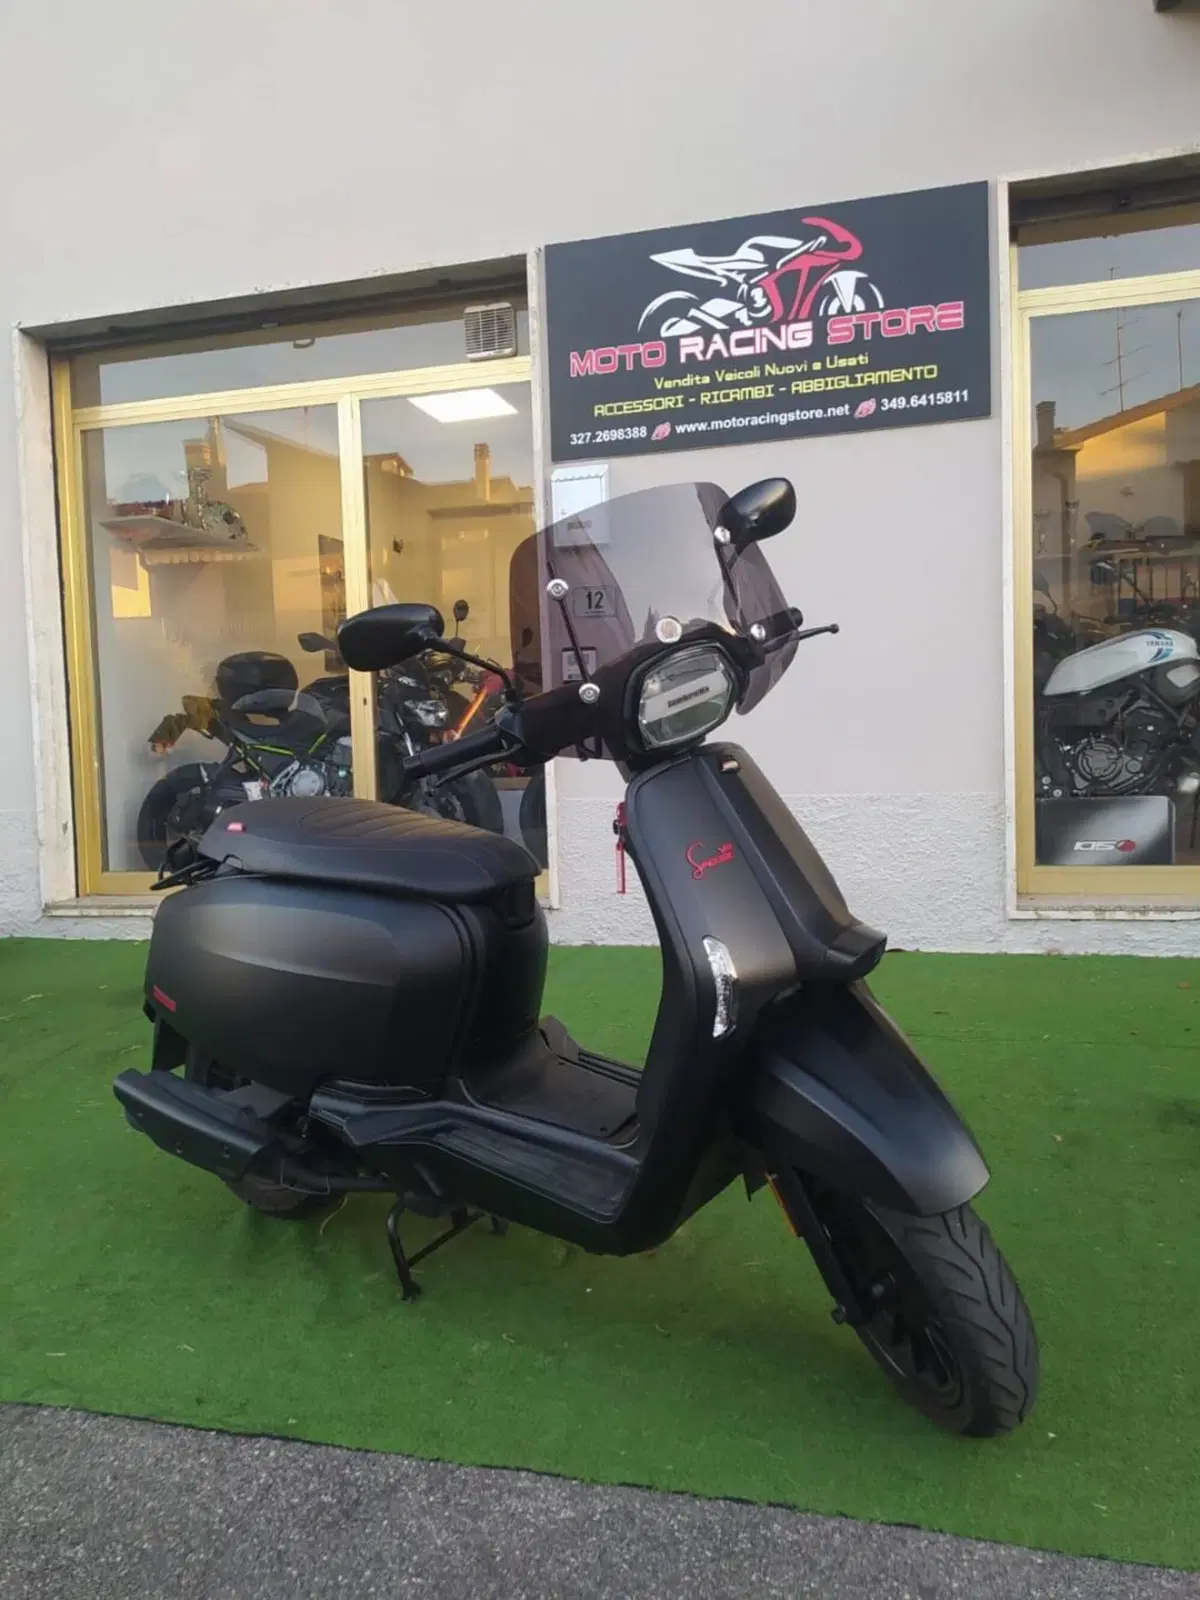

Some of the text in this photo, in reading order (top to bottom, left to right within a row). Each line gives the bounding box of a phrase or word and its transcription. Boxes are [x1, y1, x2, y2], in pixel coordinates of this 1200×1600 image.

[569, 301, 964, 377] MOTO RACING STORE
[594, 395, 685, 417] ACCESSORI
[700, 384, 775, 405] RICAMBI
[791, 365, 938, 394] ABBIGLIAMENTO
[654, 352, 869, 390] Vendita Veicoli Nuovi e Usati
[570, 389, 969, 445] 327.2698388 www.motoracingstore.net 349.6415811
[586, 590, 604, 610] 12
